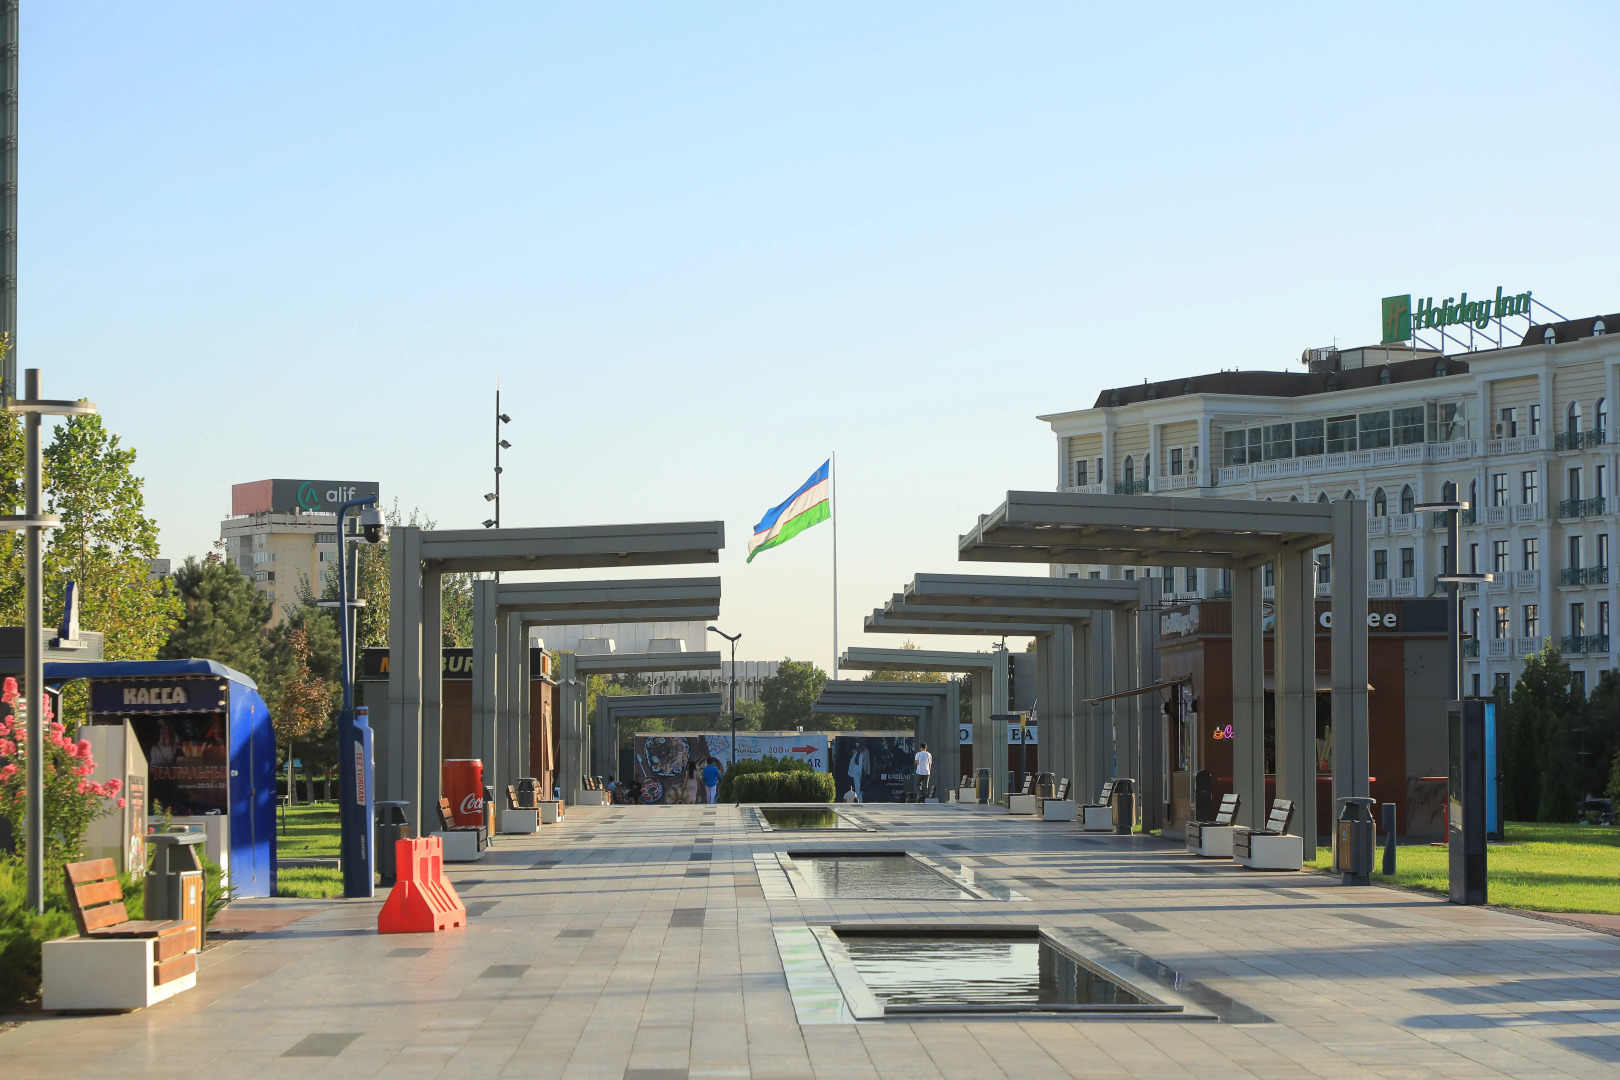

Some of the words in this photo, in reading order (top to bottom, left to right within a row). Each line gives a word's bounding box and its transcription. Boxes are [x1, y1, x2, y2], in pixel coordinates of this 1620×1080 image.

[1415, 292, 1491, 329] Holiday
[1495, 286, 1530, 318] Inn
[325, 486, 356, 502] alif
[123, 686, 188, 705] КАССА
[768, 746, 784, 754] 200
[355, 752, 363, 767] TEZ
[356, 768, 365, 803] YORDAM
